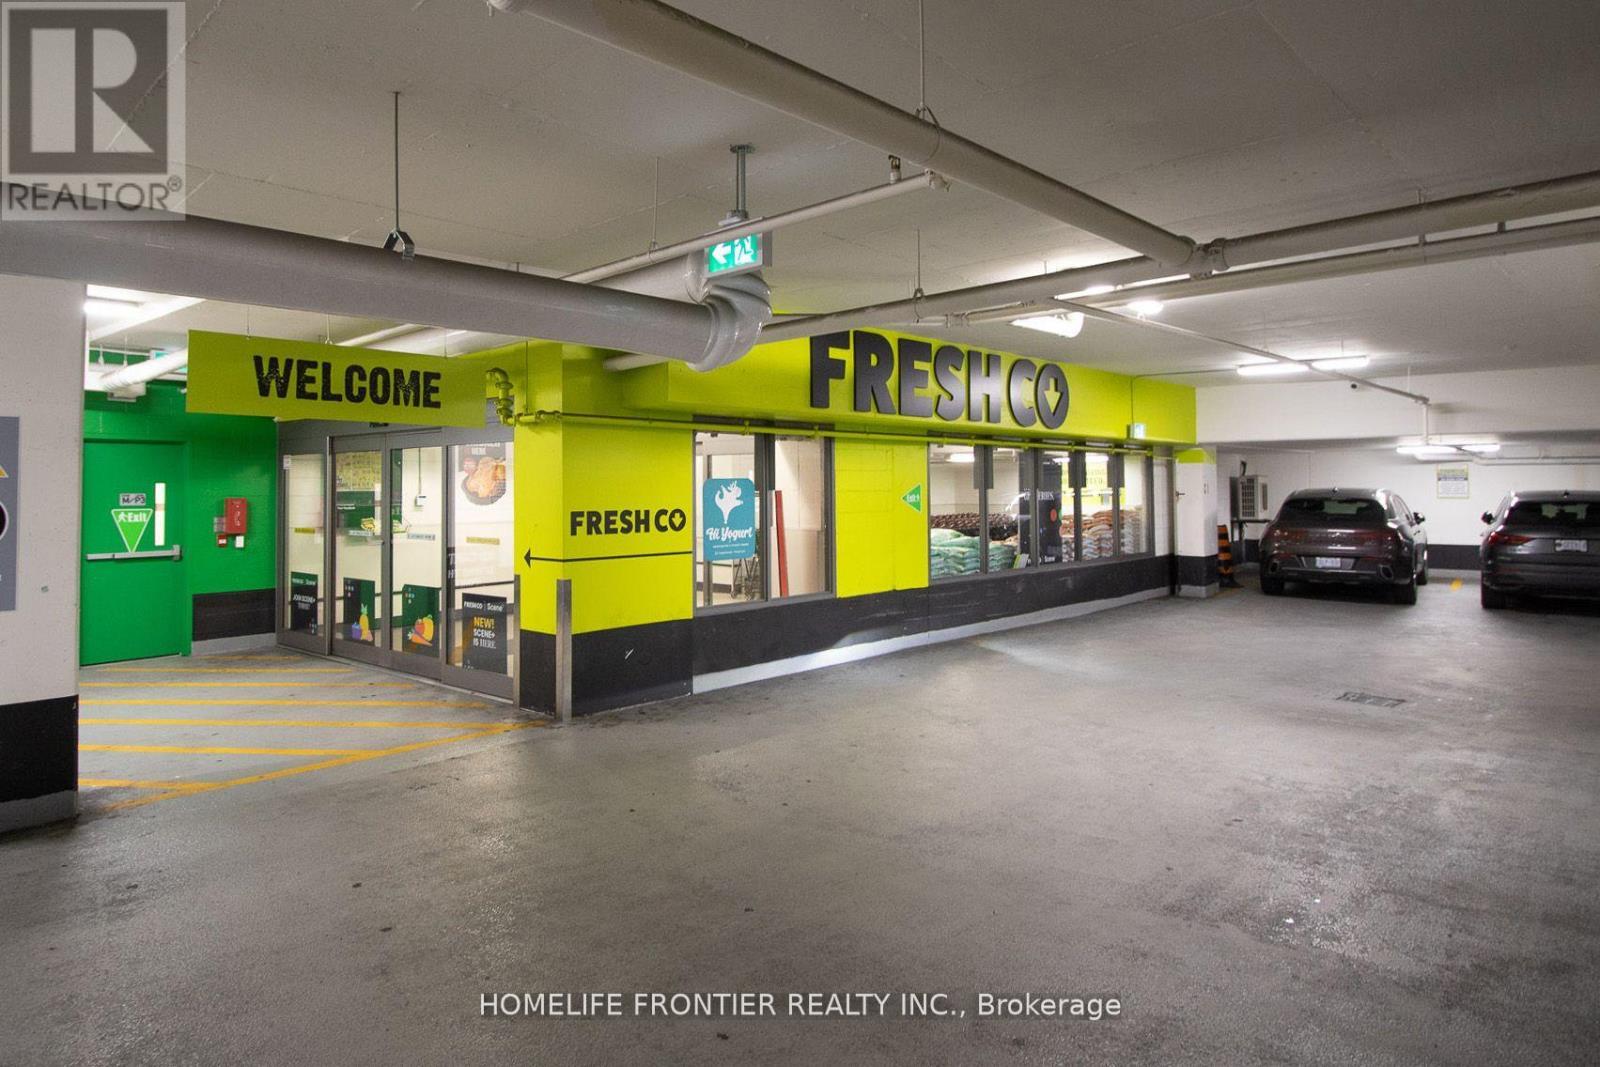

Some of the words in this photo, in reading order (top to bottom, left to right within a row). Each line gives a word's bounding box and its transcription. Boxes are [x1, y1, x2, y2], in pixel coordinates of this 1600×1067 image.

[253, 355, 441, 409] WELCOME
[127, 512, 147, 523] Exit
[705, 527, 721, 541] Hi
[720, 526, 753, 543] Yogurt
[473, 616, 495, 629] NEW!
